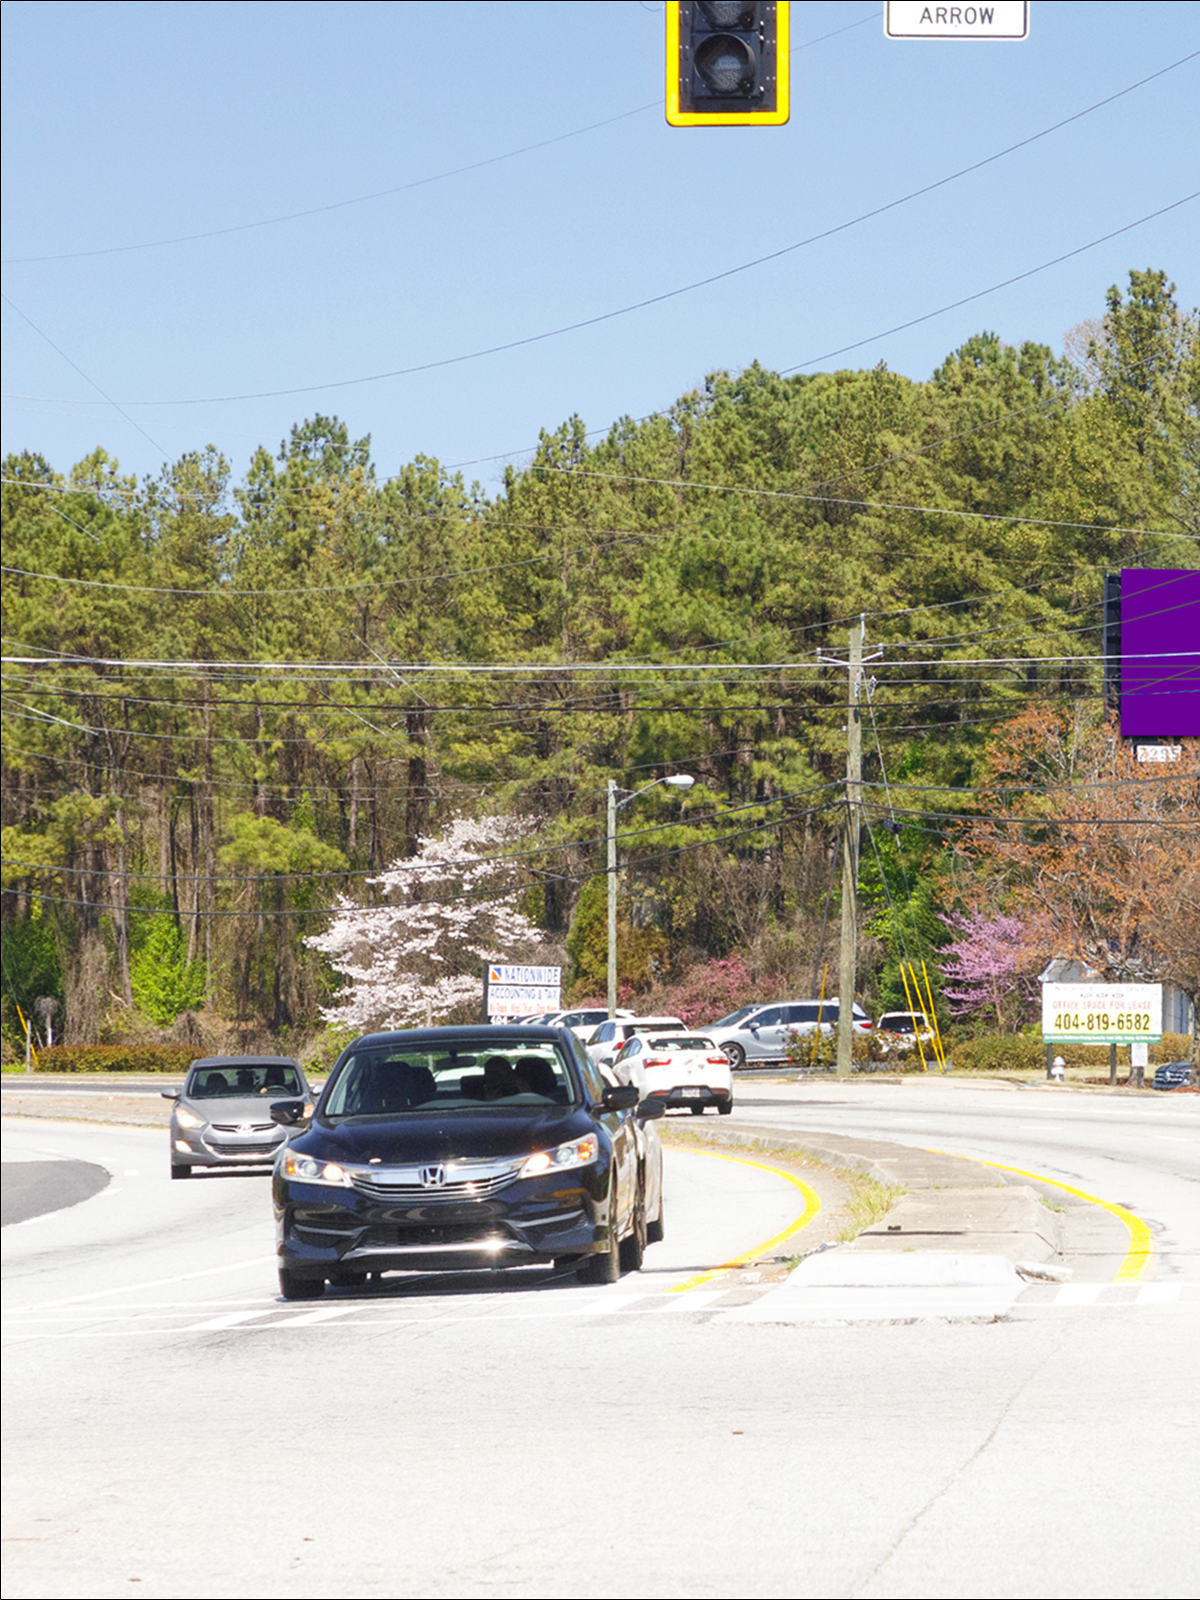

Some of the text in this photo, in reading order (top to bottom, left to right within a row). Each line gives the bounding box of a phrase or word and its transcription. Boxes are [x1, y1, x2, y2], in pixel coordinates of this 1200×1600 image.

[919, 7, 994, 24] ARROW
[505, 967, 558, 983] NATIONWIDE
[490, 987, 536, 1000] ACCOUNTING
[544, 988, 558, 1000] TAX
[1053, 1000, 1152, 1010] OFFICE SPACE FOR LEASE
[1054, 1013, 1151, 1031] 404-819-6582
